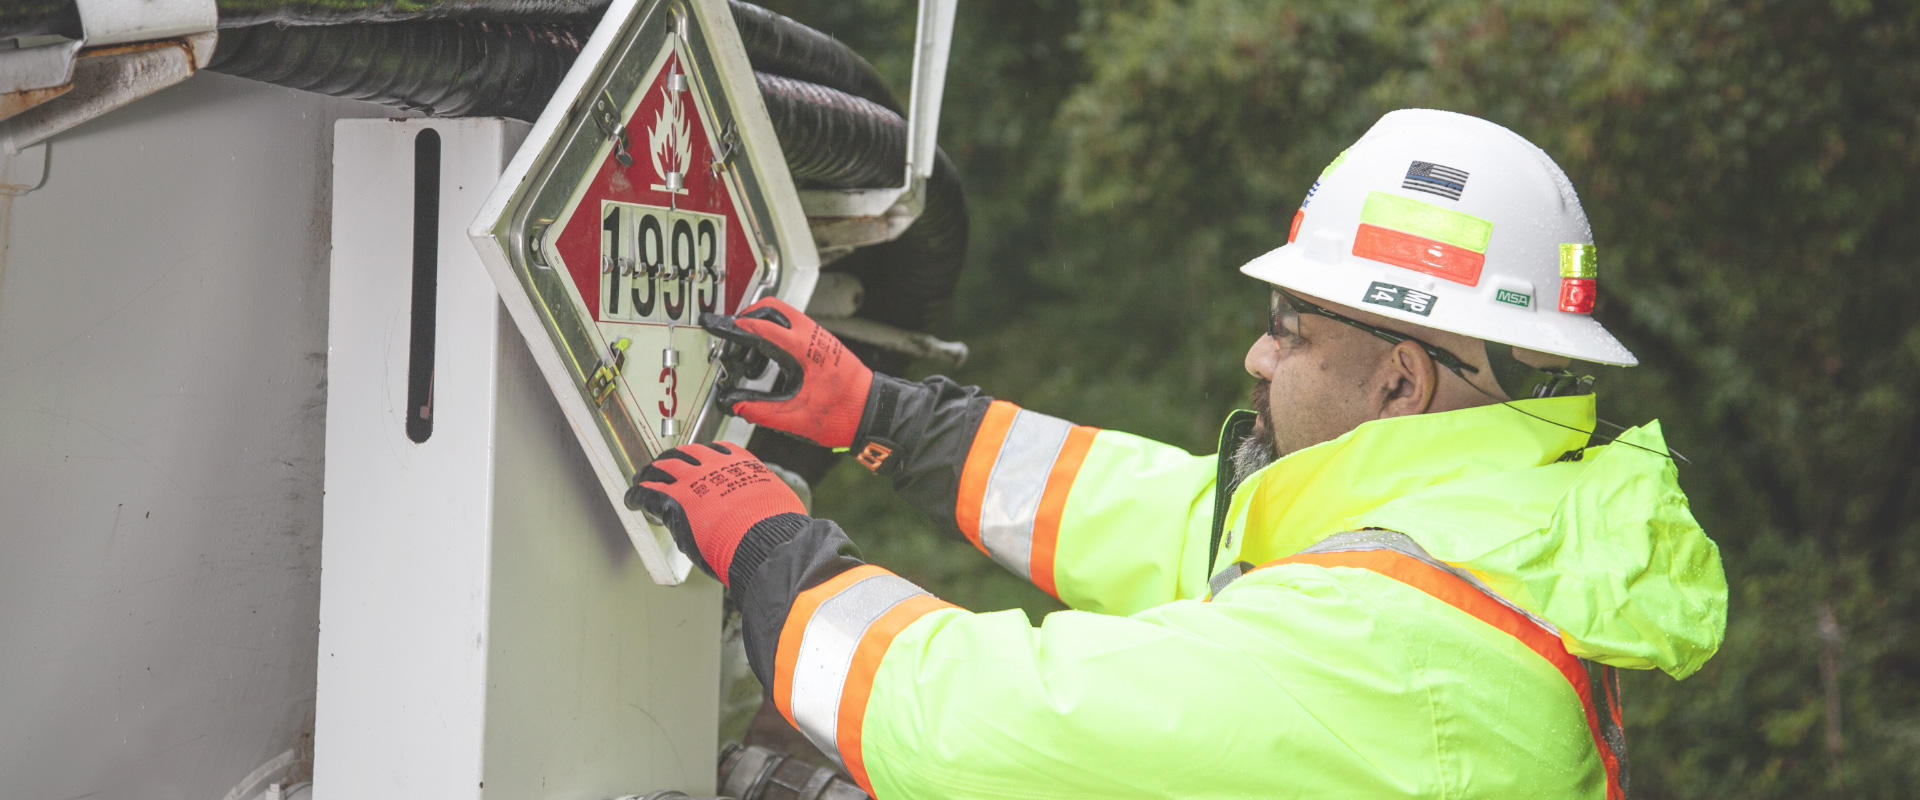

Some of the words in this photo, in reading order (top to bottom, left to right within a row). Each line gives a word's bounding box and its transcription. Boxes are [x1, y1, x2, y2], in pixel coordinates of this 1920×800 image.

[603, 206, 718, 320] 1993
[1371, 286, 1398, 302] 14
[1403, 290, 1432, 312] MP
[1498, 290, 1528, 306] MSA
[658, 367, 678, 417] 3
